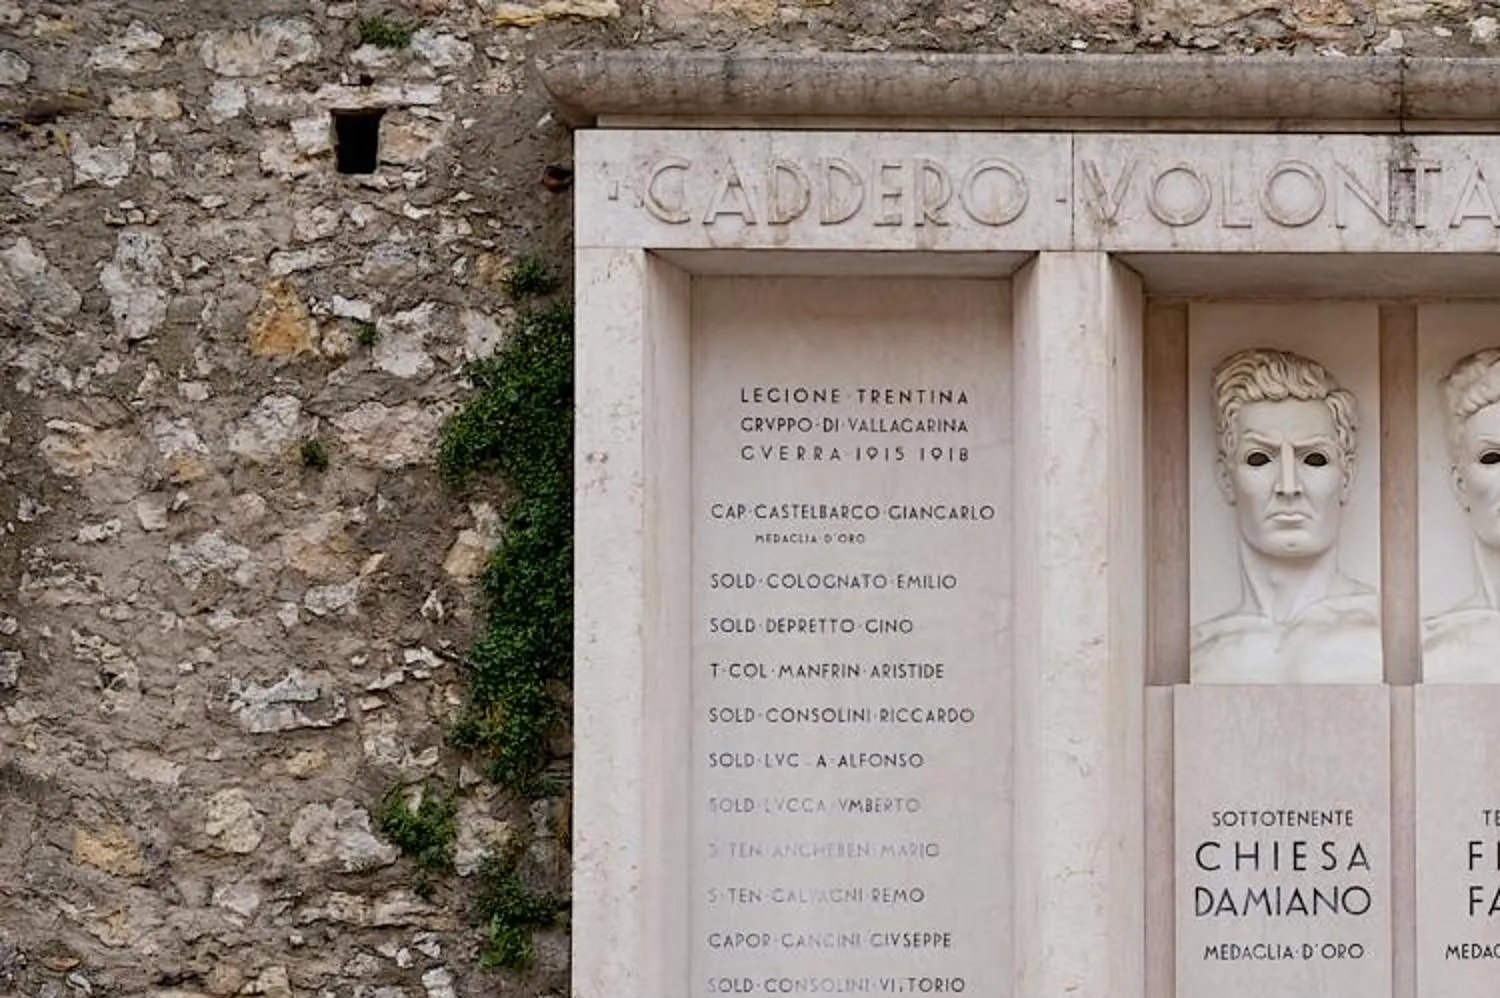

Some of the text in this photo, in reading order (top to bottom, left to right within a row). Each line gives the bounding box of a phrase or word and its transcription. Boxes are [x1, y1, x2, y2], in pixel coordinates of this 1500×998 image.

[642, 157, 1029, 228] CADDERO
[856, 387, 970, 404] TRENTINA
[822, 417, 840, 433] DI
[854, 445, 906, 462] 1915
[919, 445, 970, 462] 1918
[710, 504, 996, 521] CAP CASTELBARCO GIANCARLO
[710, 573, 756, 590] SOLD
[896, 573, 958, 590] EMILIO
[709, 617, 756, 634] SOLD
[765, 617, 856, 634] DEPRETTO
[709, 663, 945, 680] T COL MANFRIN ARISTIDE
[708, 707, 975, 724] SOLD CONSOLINI RICCARDO
[708, 752, 755, 769] SOLD
[836, 752, 926, 769] ALFONSO
[708, 797, 755, 813] SOLD
[1212, 810, 1354, 828] SOTTOTENENTE
[727, 842, 763, 858] TEN
[879, 842, 940, 858] MARIO
[1195, 841, 1372, 871] CHIESA
[726, 887, 763, 903] TEN
[871, 887, 926, 903] REMO
[1194, 885, 1372, 918] DAMIANO
[1301, 943, 1365, 961] D'ORO
[706, 977, 754, 994] SOLD
[763, 977, 870, 994] CONSOLINI
